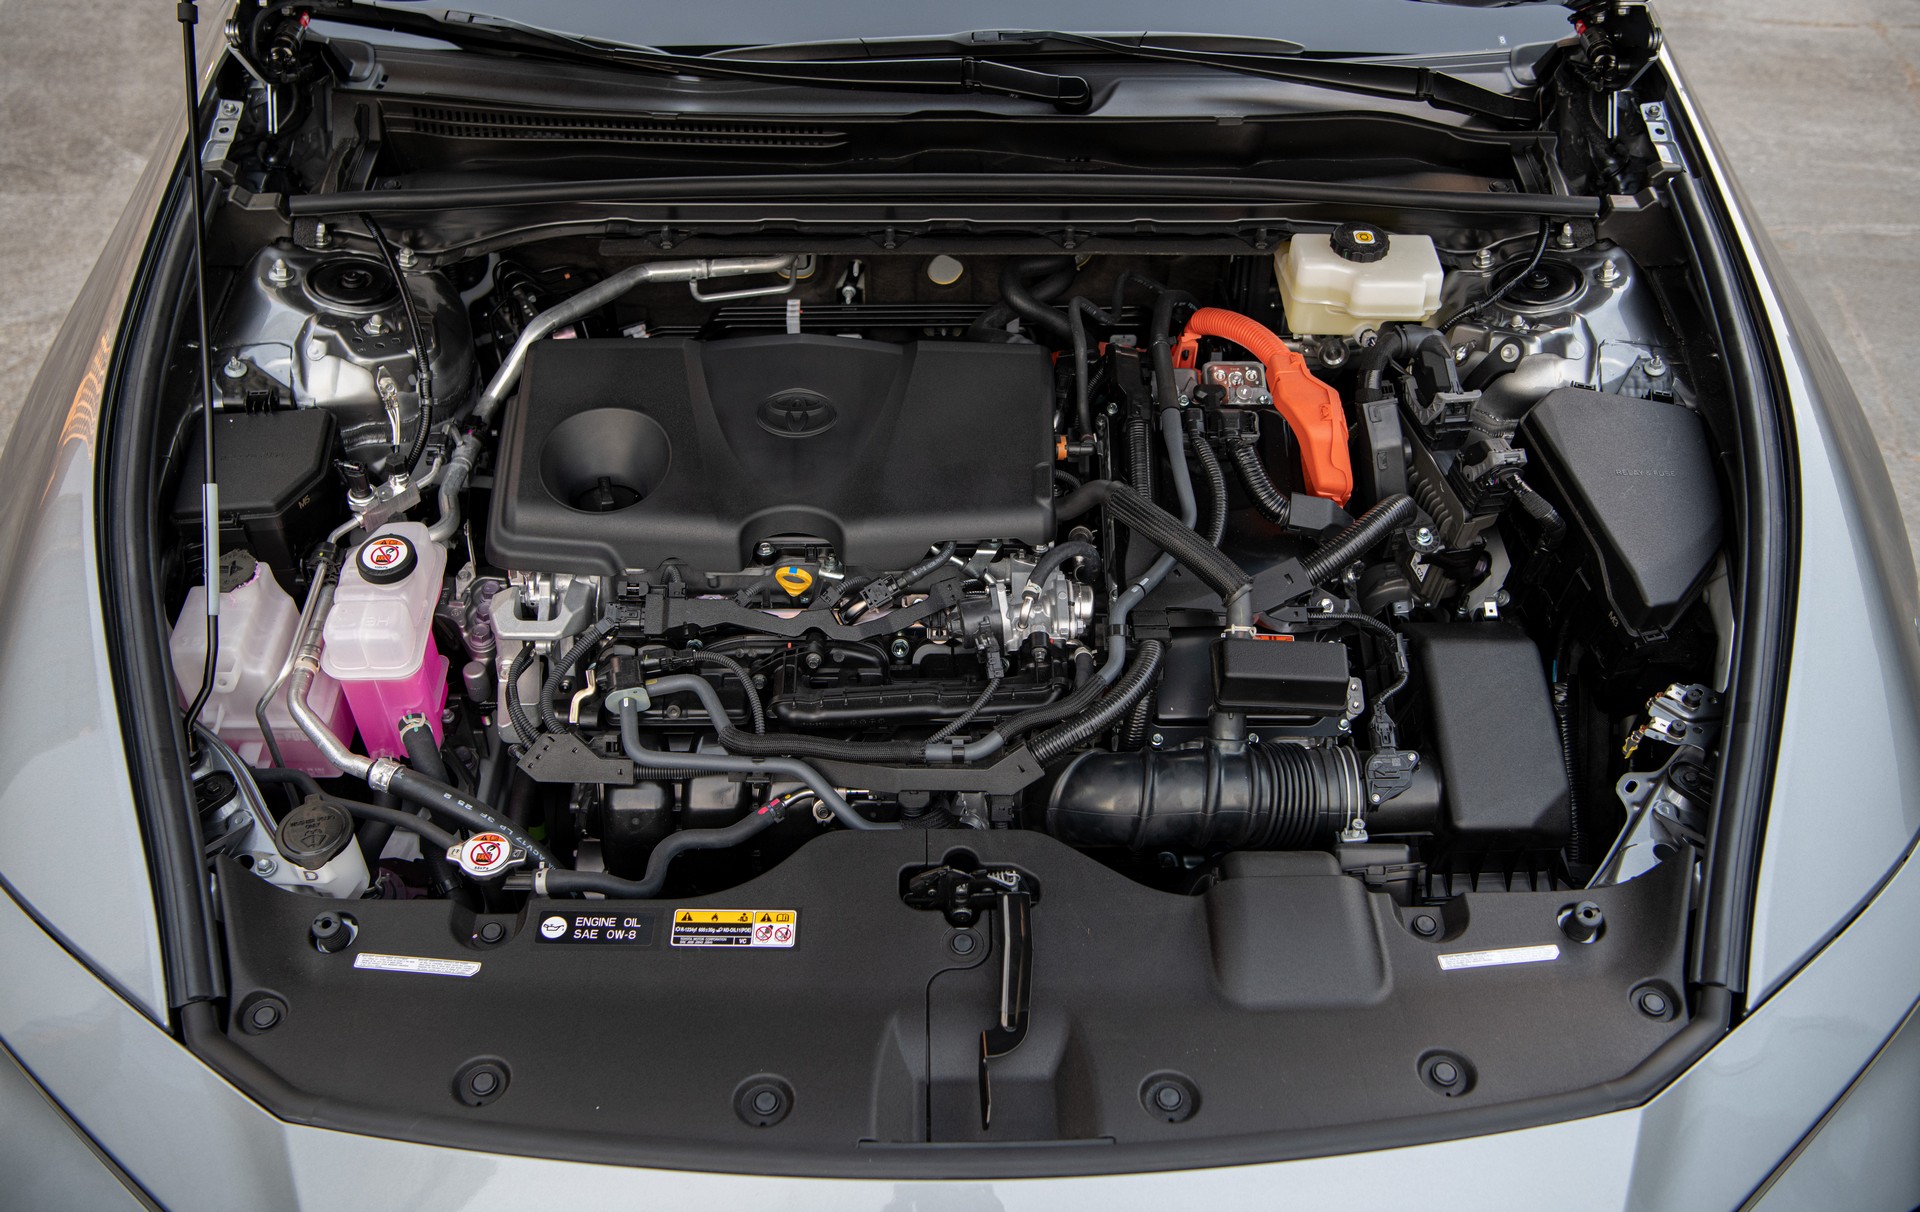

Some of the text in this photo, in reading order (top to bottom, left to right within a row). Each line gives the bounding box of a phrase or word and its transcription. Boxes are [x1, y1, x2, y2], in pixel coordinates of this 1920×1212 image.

[1615, 468, 1643, 476] RELAY
[499, 824, 514, 835] LP
[516, 836, 546, 861] ACV17
[575, 917, 642, 928] ENGINE OIL
[573, 929, 599, 940] SAE
